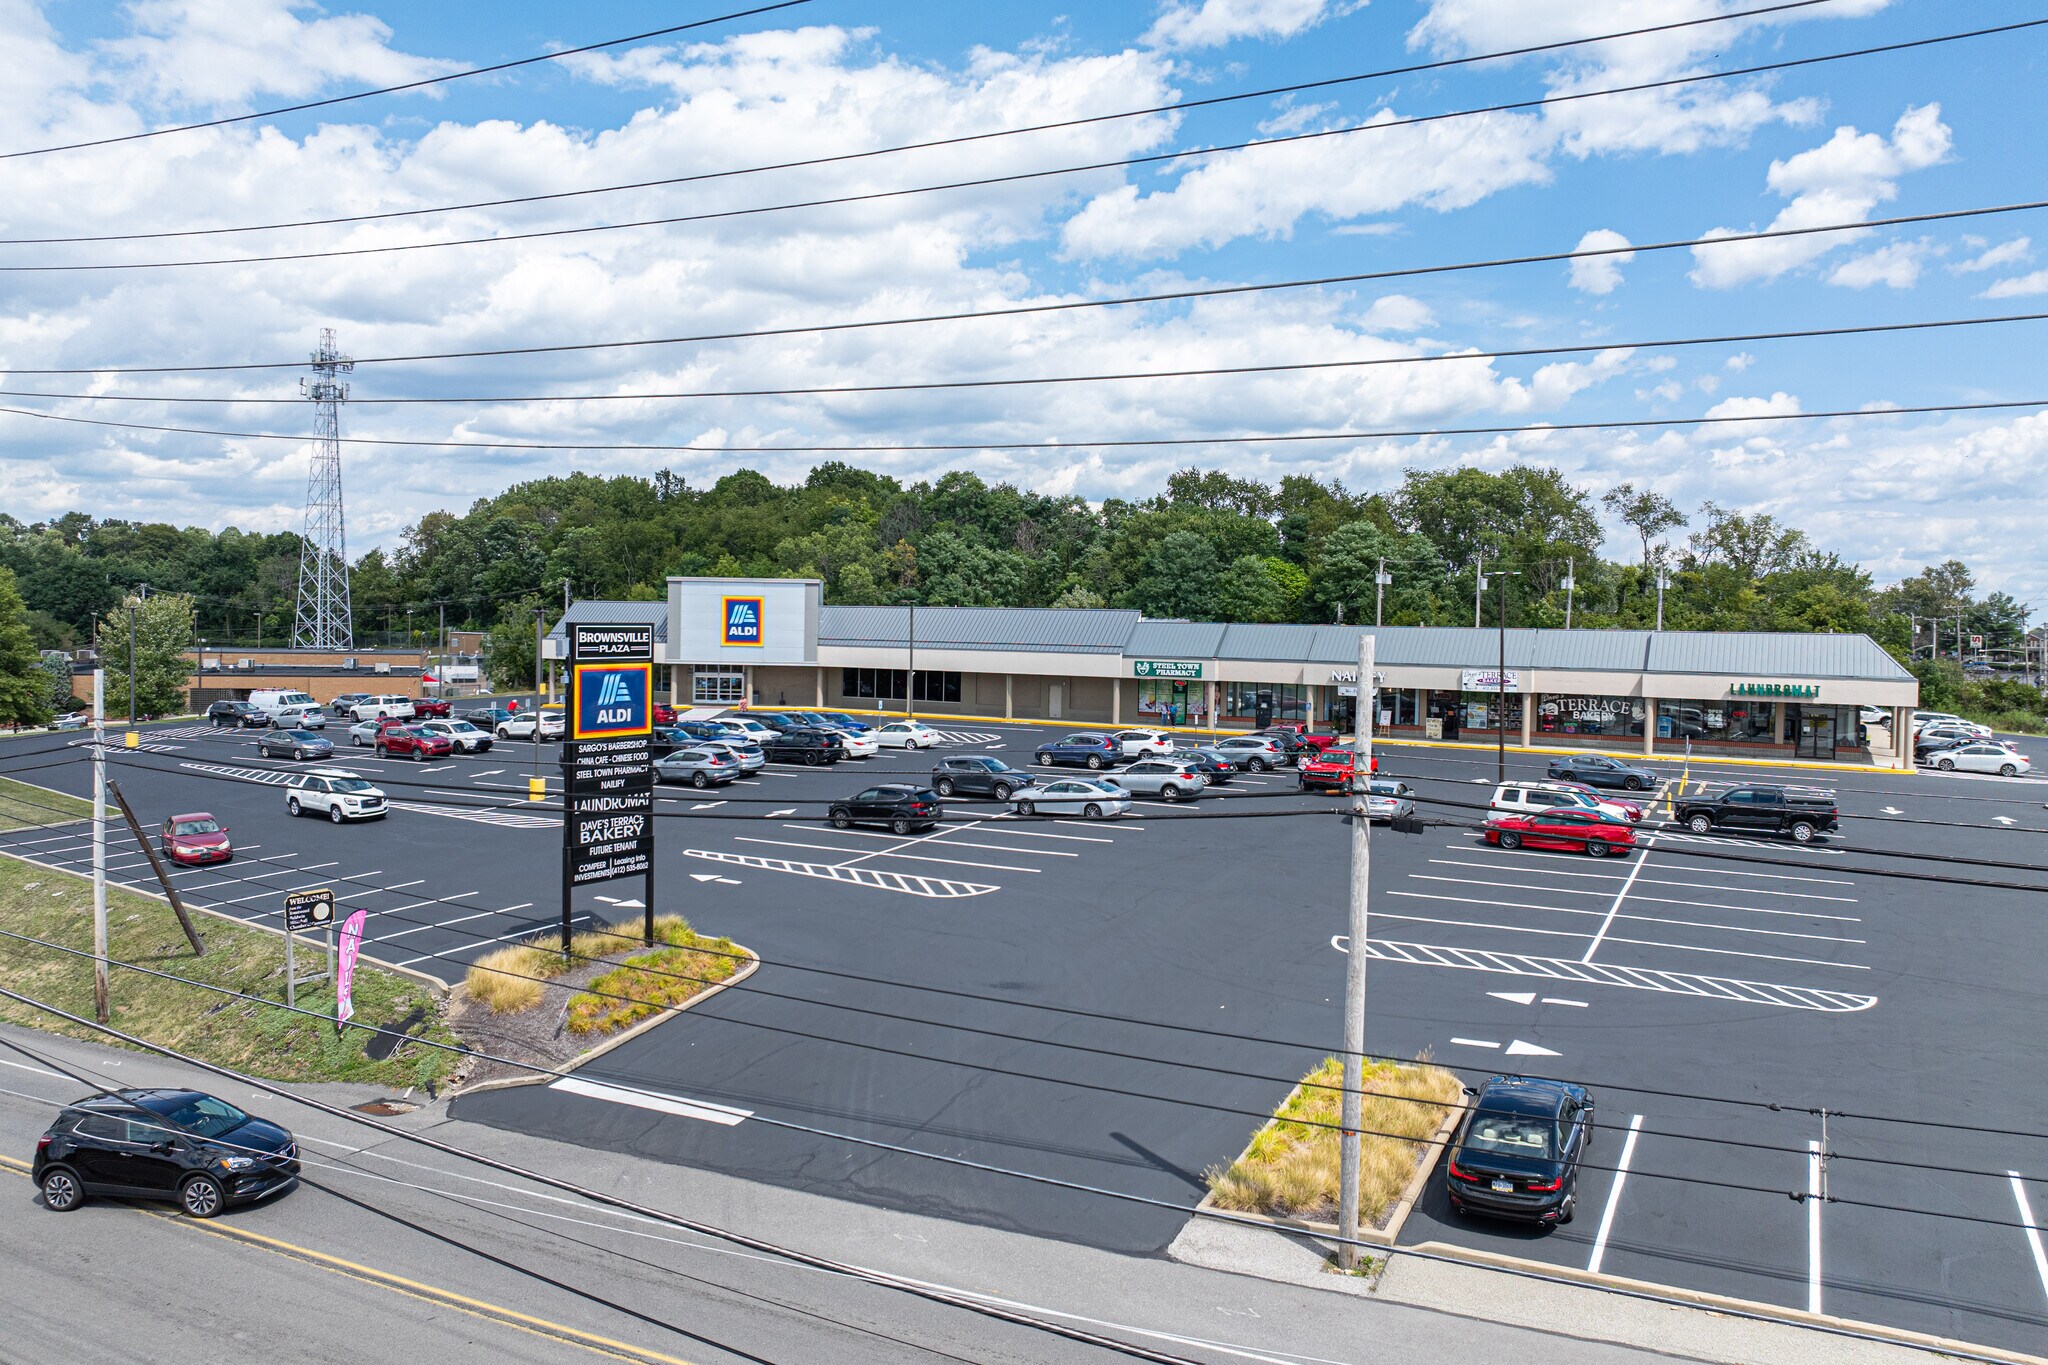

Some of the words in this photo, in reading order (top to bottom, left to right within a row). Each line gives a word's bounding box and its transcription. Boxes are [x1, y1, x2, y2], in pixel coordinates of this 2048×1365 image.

[579, 632, 649, 643] BROWNSVILLE
[729, 626, 757, 636] ALDI
[599, 645, 630, 653] PLAZA
[1155, 669, 1197, 677] PHARMACY
[1331, 670, 1387, 683] NAIY
[1730, 683, 1821, 698] LAUNDROMAT
[1556, 698, 1631, 715] TERRACE
[597, 708, 632, 724] ALDI
[1573, 711, 1615, 721] BAKERY
[1707, 713, 1723, 722] 24
[578, 743, 607, 753] SARGO'S
[608, 740, 648, 750] BARBERSHOP
[576, 757, 594, 765] CHINA
[595, 756, 609, 764] CAFE
[612, 753, 633, 763] CHINESE
[633, 752, 649, 761] FOOD
[576, 770, 593, 779] STEEL
[594, 768, 613, 777] TOWN
[614, 764, 649, 776] PHARMACY
[600, 779, 625, 790] NAILIFY
[574, 792, 651, 815] LAUNDROMAT
[580, 818, 609, 832] DAVE'S
[610, 814, 645, 828] TERRACE
[580, 823, 644, 844] BAKERY
[589, 843, 613, 856] FUTURE
[613, 840, 638, 852] TENANT
[578, 860, 607, 873] COMPEER
[614, 856, 636, 866] Leasing
[635, 854, 646, 862] Info
[574, 868, 611, 882] INVESTMENTS
[611, 866, 626, 876] (412)
[289, 893, 330, 905] WELCOME!
